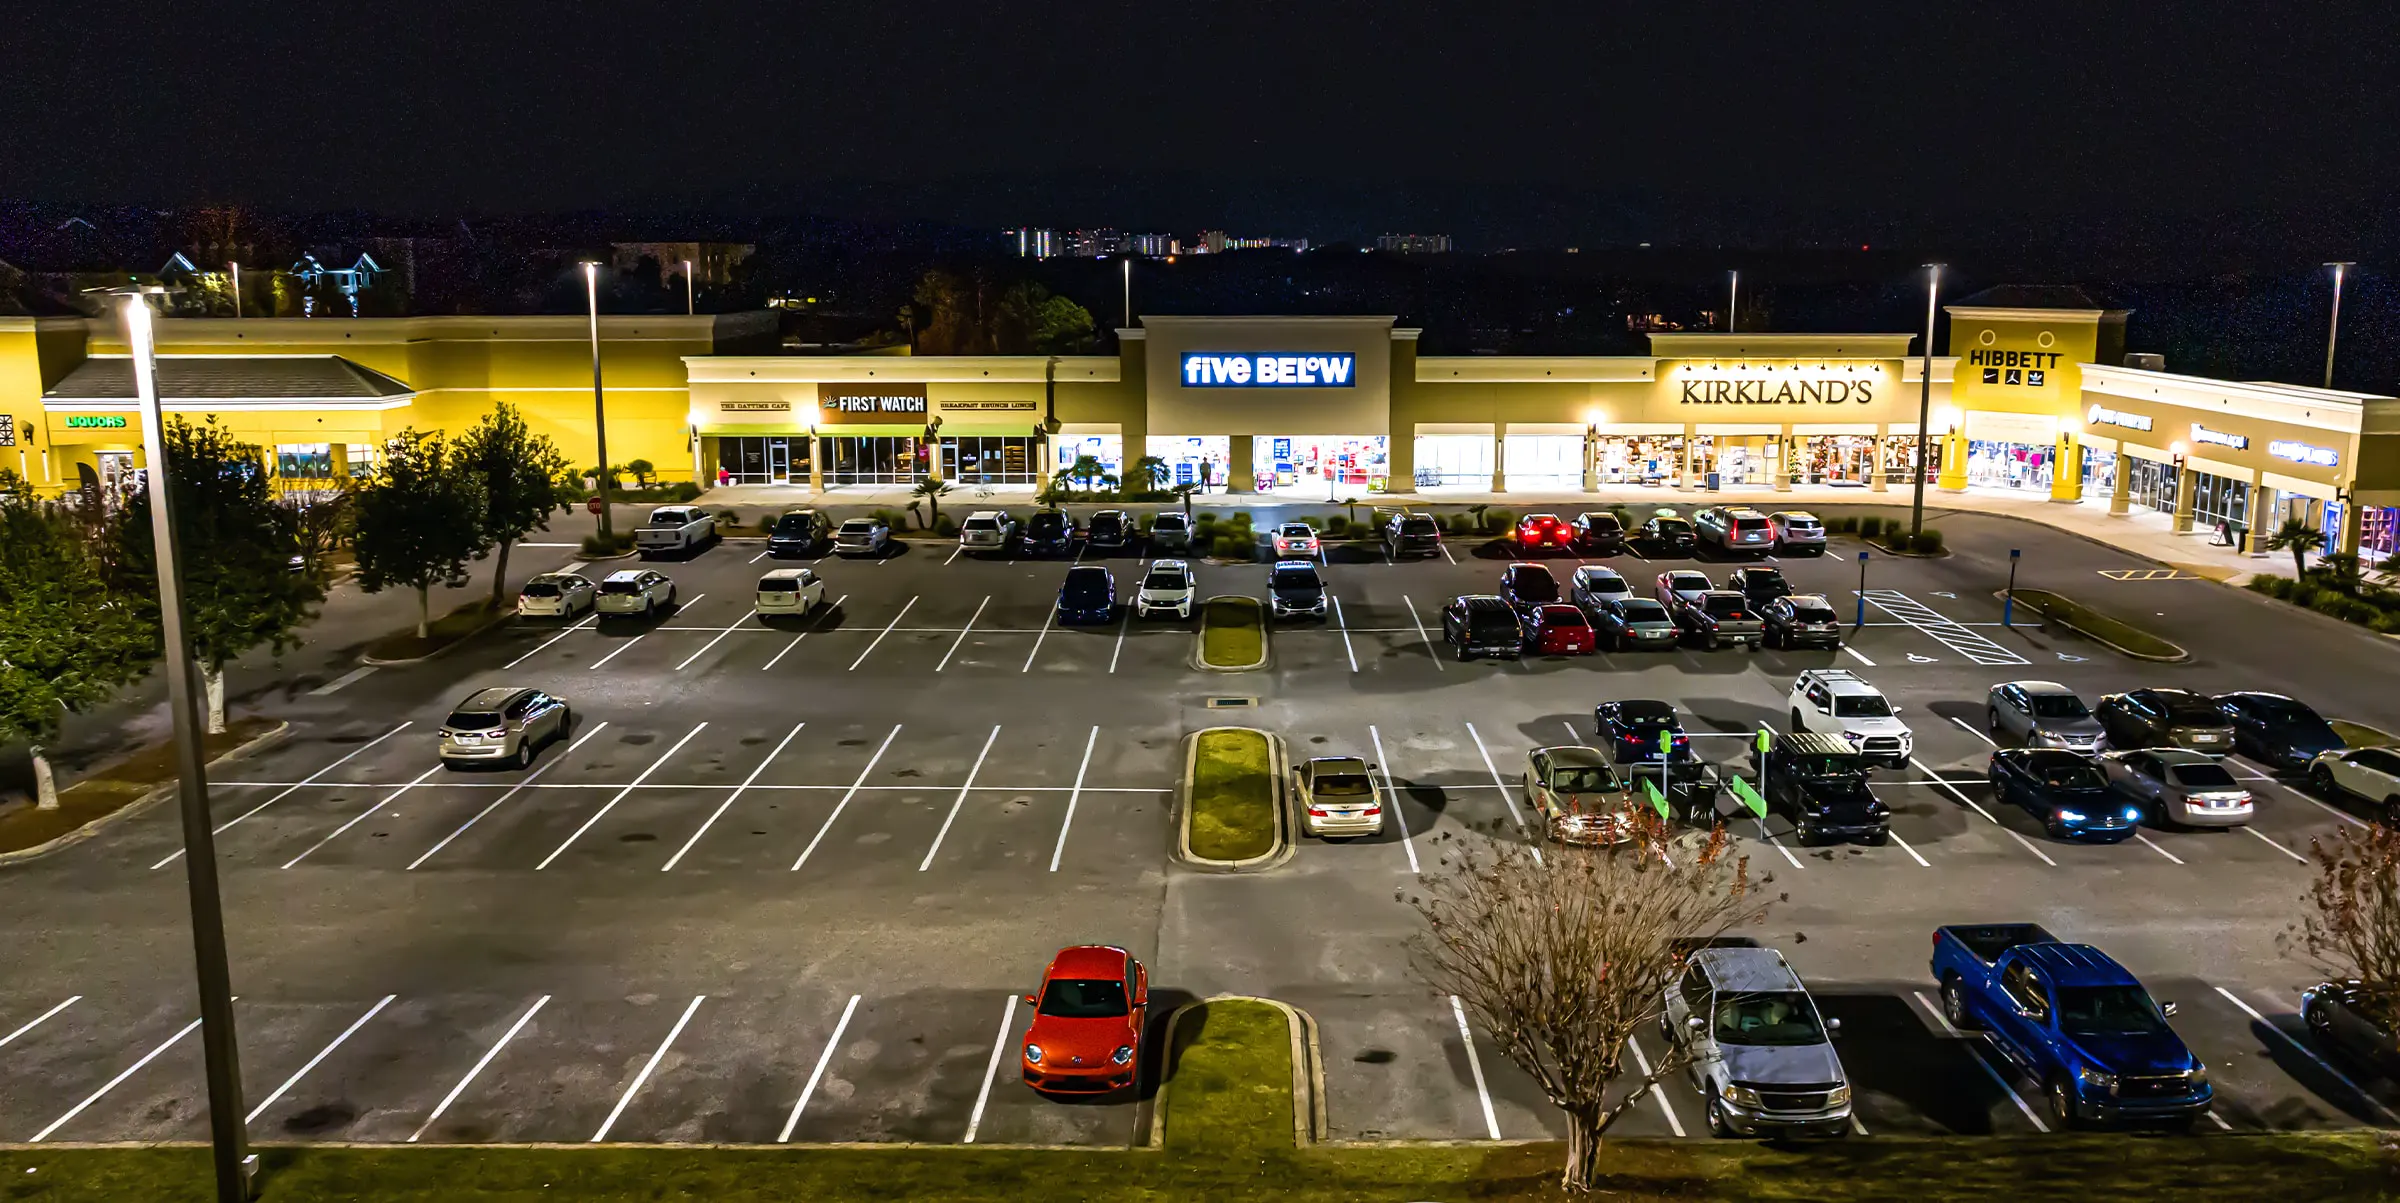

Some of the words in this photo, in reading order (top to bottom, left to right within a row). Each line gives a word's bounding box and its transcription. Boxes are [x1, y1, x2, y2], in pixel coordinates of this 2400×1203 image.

[1970, 350, 2064, 369] HIBBETT
[1185, 356, 1251, 383] five
[1680, 379, 1872, 404] KIRKLAND'S
[839, 396, 877, 412] FIRST
[879, 396, 924, 412] WATCH
[65, 416, 126, 428] LIQUORS
